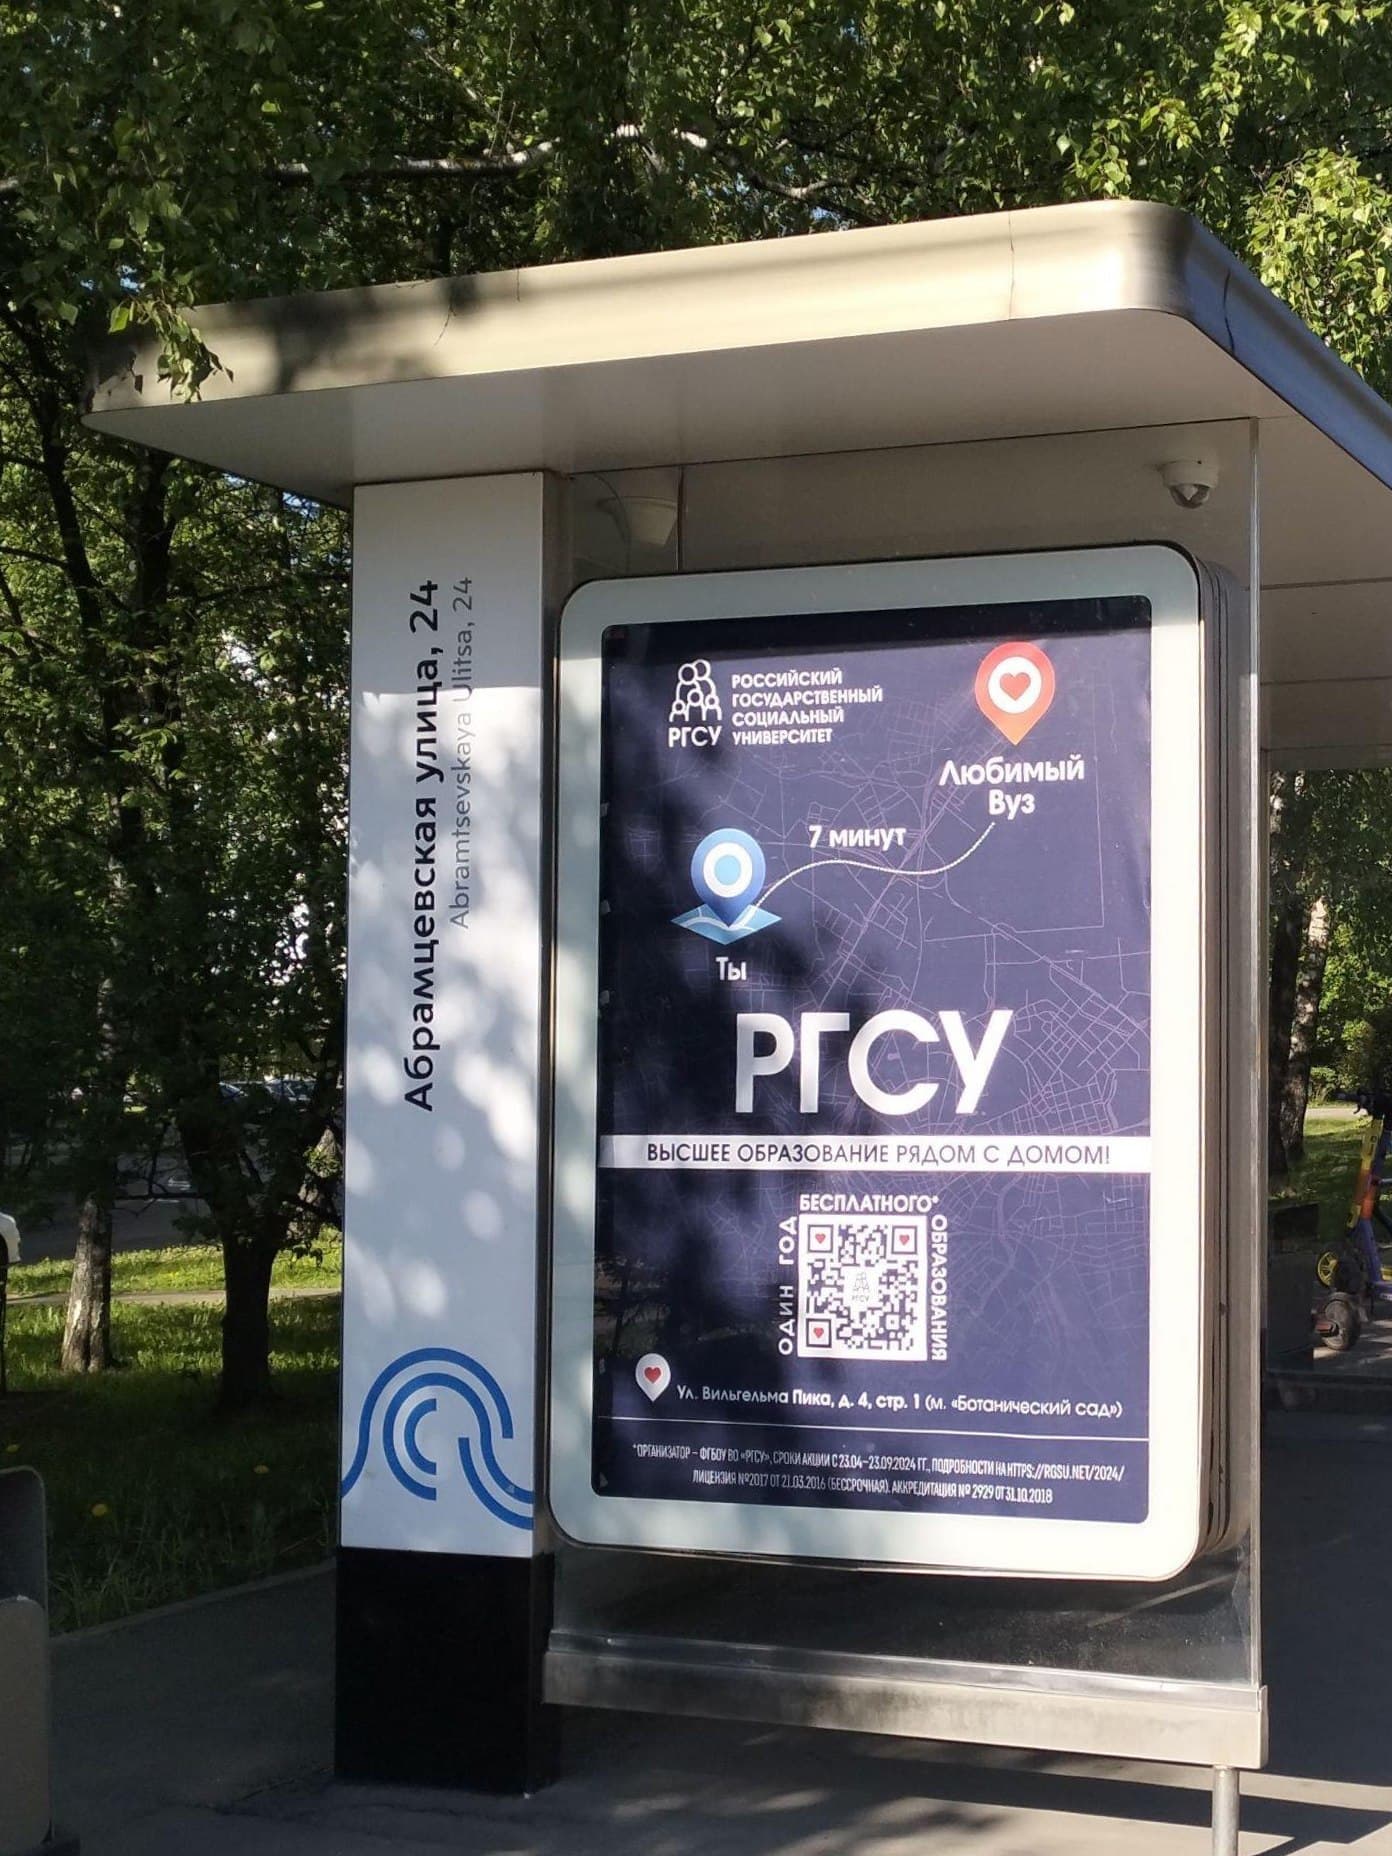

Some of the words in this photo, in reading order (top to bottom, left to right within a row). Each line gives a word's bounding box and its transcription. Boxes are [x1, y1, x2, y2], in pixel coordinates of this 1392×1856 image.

[409, 580, 438, 632] 24
[453, 576, 472, 614] 24
[451, 622, 475, 703] Ulitsa,
[732, 668, 843, 688] РОССИЙСКИЙ
[416, 642, 444, 782] улица,
[732, 685, 884, 708] ГОСУДАРСТВЕННЫЙ
[732, 706, 844, 727] СОЦИАЛЬНЫЙ
[668, 726, 722, 747] РГСУ
[732, 728, 832, 746] УНИВЕРСИТЕТ
[938, 754, 1085, 787] Любимый
[448, 712, 473, 929] Abramtsevskaya
[988, 789, 1036, 820] Вуз
[808, 825, 824, 848] 7
[829, 828, 906, 851] минут
[404, 798, 441, 1112] Абрамцевская
[716, 957, 747, 981] Ты
[734, 1009, 1013, 1115] РГСУ
[647, 1143, 730, 1162] ВЫСШЕЕ
[737, 1144, 889, 1164] ОБРАЗОВАНИЕ
[897, 1145, 975, 1166] РЯДОМ
[983, 1145, 1000, 1164] С
[1006, 1145, 1110, 1167] ДОМОМ!
[779, 1217, 797, 1265] ГОД
[931, 1214, 948, 1360] ОБРАЗОВАНИЯ
[778, 1286, 795, 1355] ОДИН
[677, 1385, 698, 1400] Ул.
[702, 1386, 788, 1404] Вильгельма
[793, 1389, 835, 1408] Пика,
[838, 1395, 854, 1408] д.
[857, 1392, 872, 1410] 4,
[876, 1395, 908, 1412] стр.
[913, 1393, 920, 1409] 1
[925, 1394, 946, 1412] (м.
[951, 1394, 1071, 1415] «Ботанический
[1075, 1400, 1123, 1418] сад»)
[699, 1446, 727, 1462] ФГБОУ
[773, 1451, 801, 1466] СРОКИ
[801, 1452, 830, 1468] АКЦИИ
[931, 1459, 994, 1476] ПОДРОБНОСТИ
[692, 1469, 737, 1486] ЛИЦЕНЗИЯ
[770, 1473, 780, 1487] ОТ
[781, 1474, 825, 1490] 21.03.2016
[892, 1480, 957, 1498] АККРЕДИТАЦИЯ
